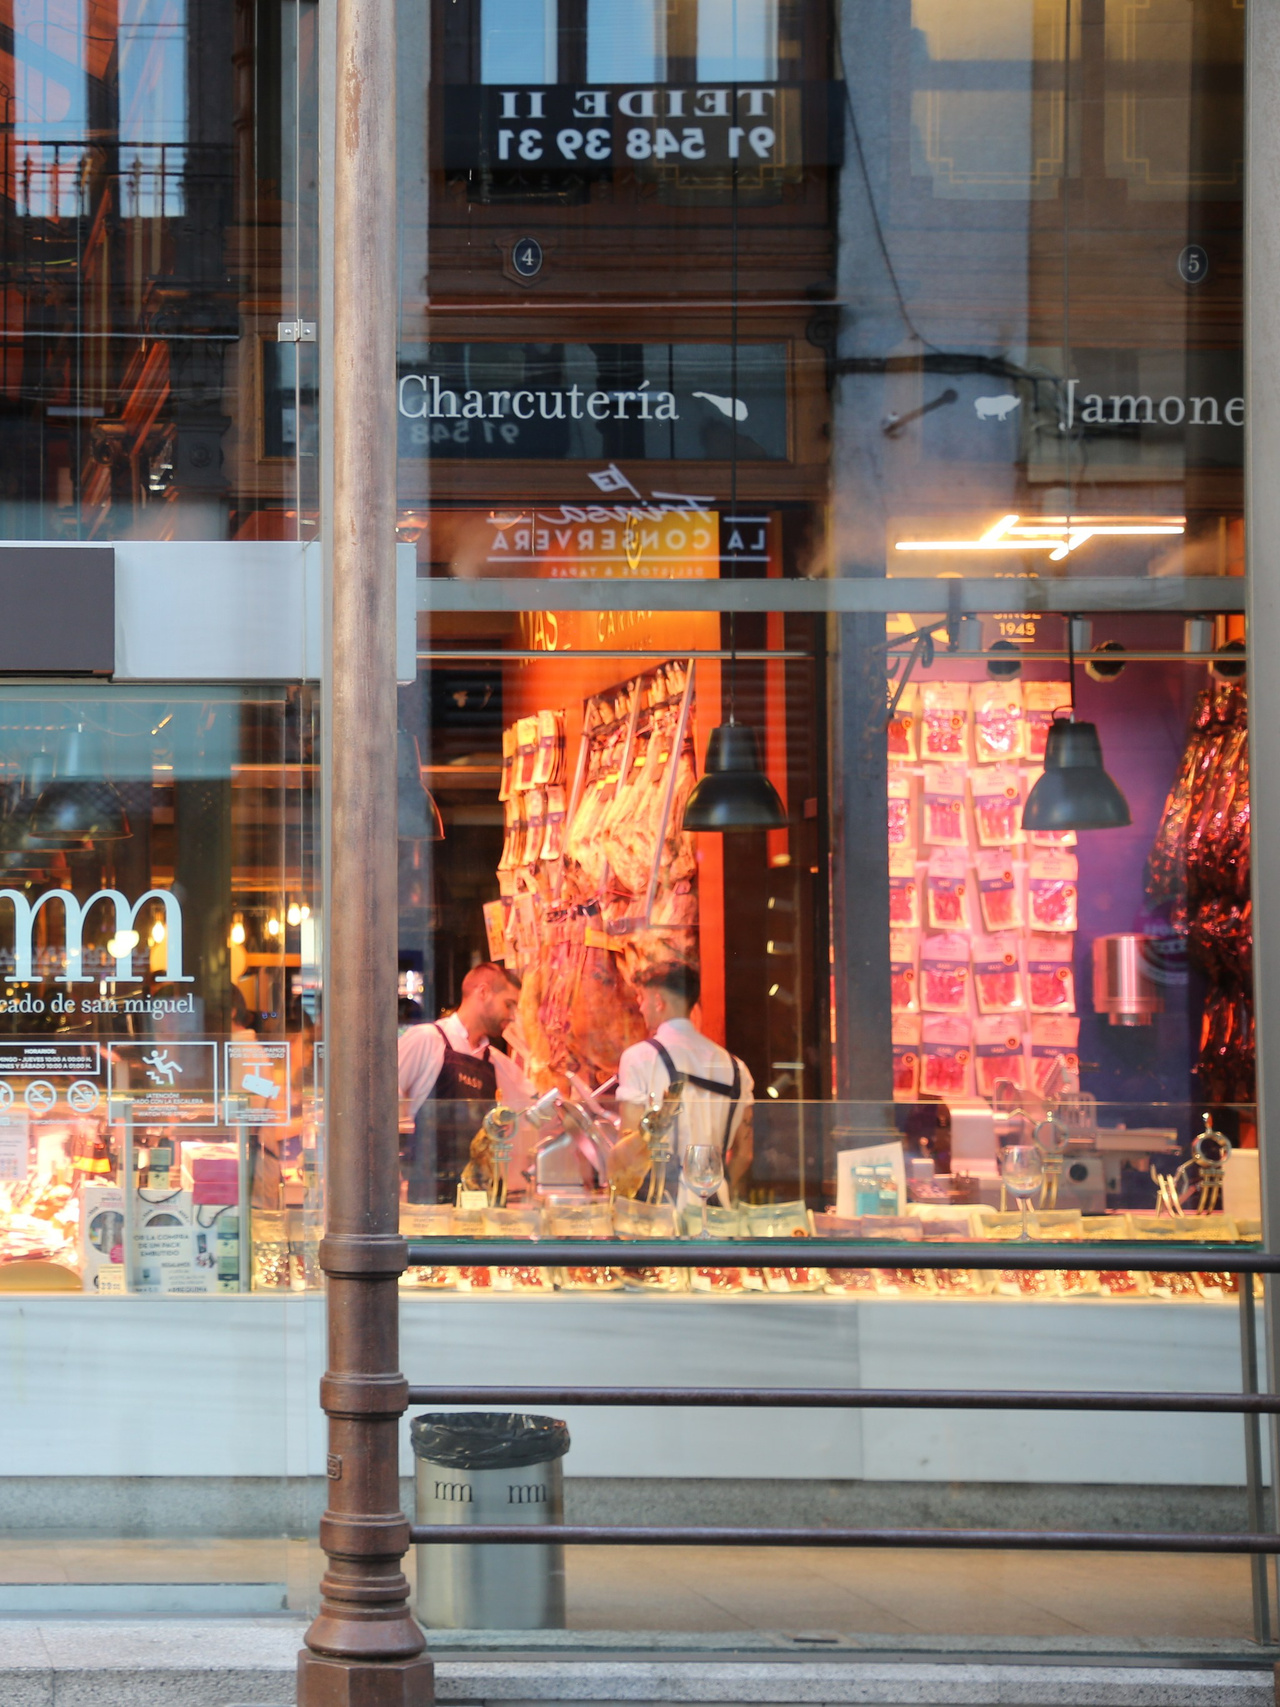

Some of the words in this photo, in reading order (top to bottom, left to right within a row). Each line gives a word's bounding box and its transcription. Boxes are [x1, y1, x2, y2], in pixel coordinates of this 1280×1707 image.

[522, 247, 534, 266] 4
[1188, 253, 1200, 273] 5
[398, 374, 680, 420] Charcutería
[999, 622, 1036, 636] 1945
[50, 993, 76, 1014] de
[81, 998, 118, 1014] san
[123, 993, 195, 1020] miguel
